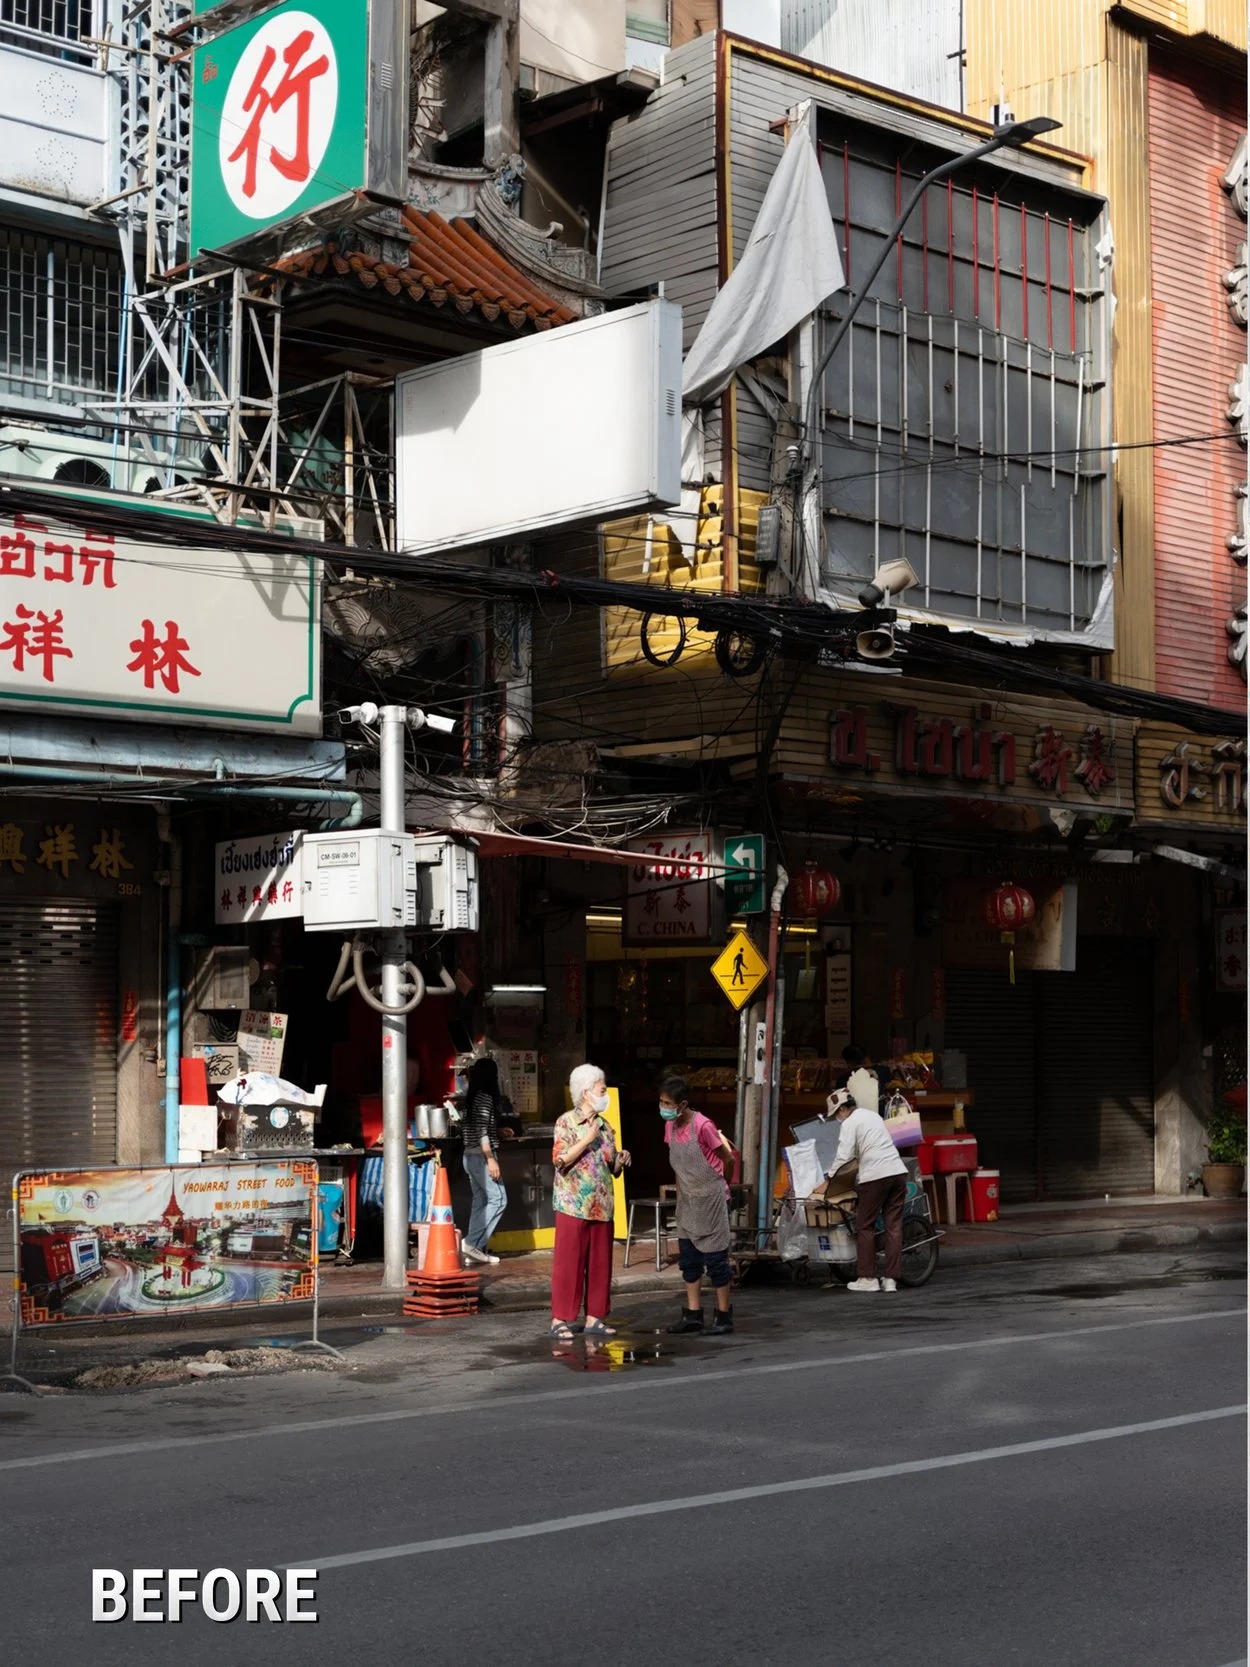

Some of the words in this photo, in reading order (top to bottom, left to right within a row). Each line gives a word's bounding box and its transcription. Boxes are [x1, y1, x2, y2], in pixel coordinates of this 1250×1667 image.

[228, 30, 329, 199] 行
[117, 883, 142, 897] 384
[654, 921, 696, 935] CHINA
[183, 1181, 229, 1194] YAOWARAJ
[237, 1178, 267, 1191] STREET
[275, 1177, 296, 1188] FOOD
